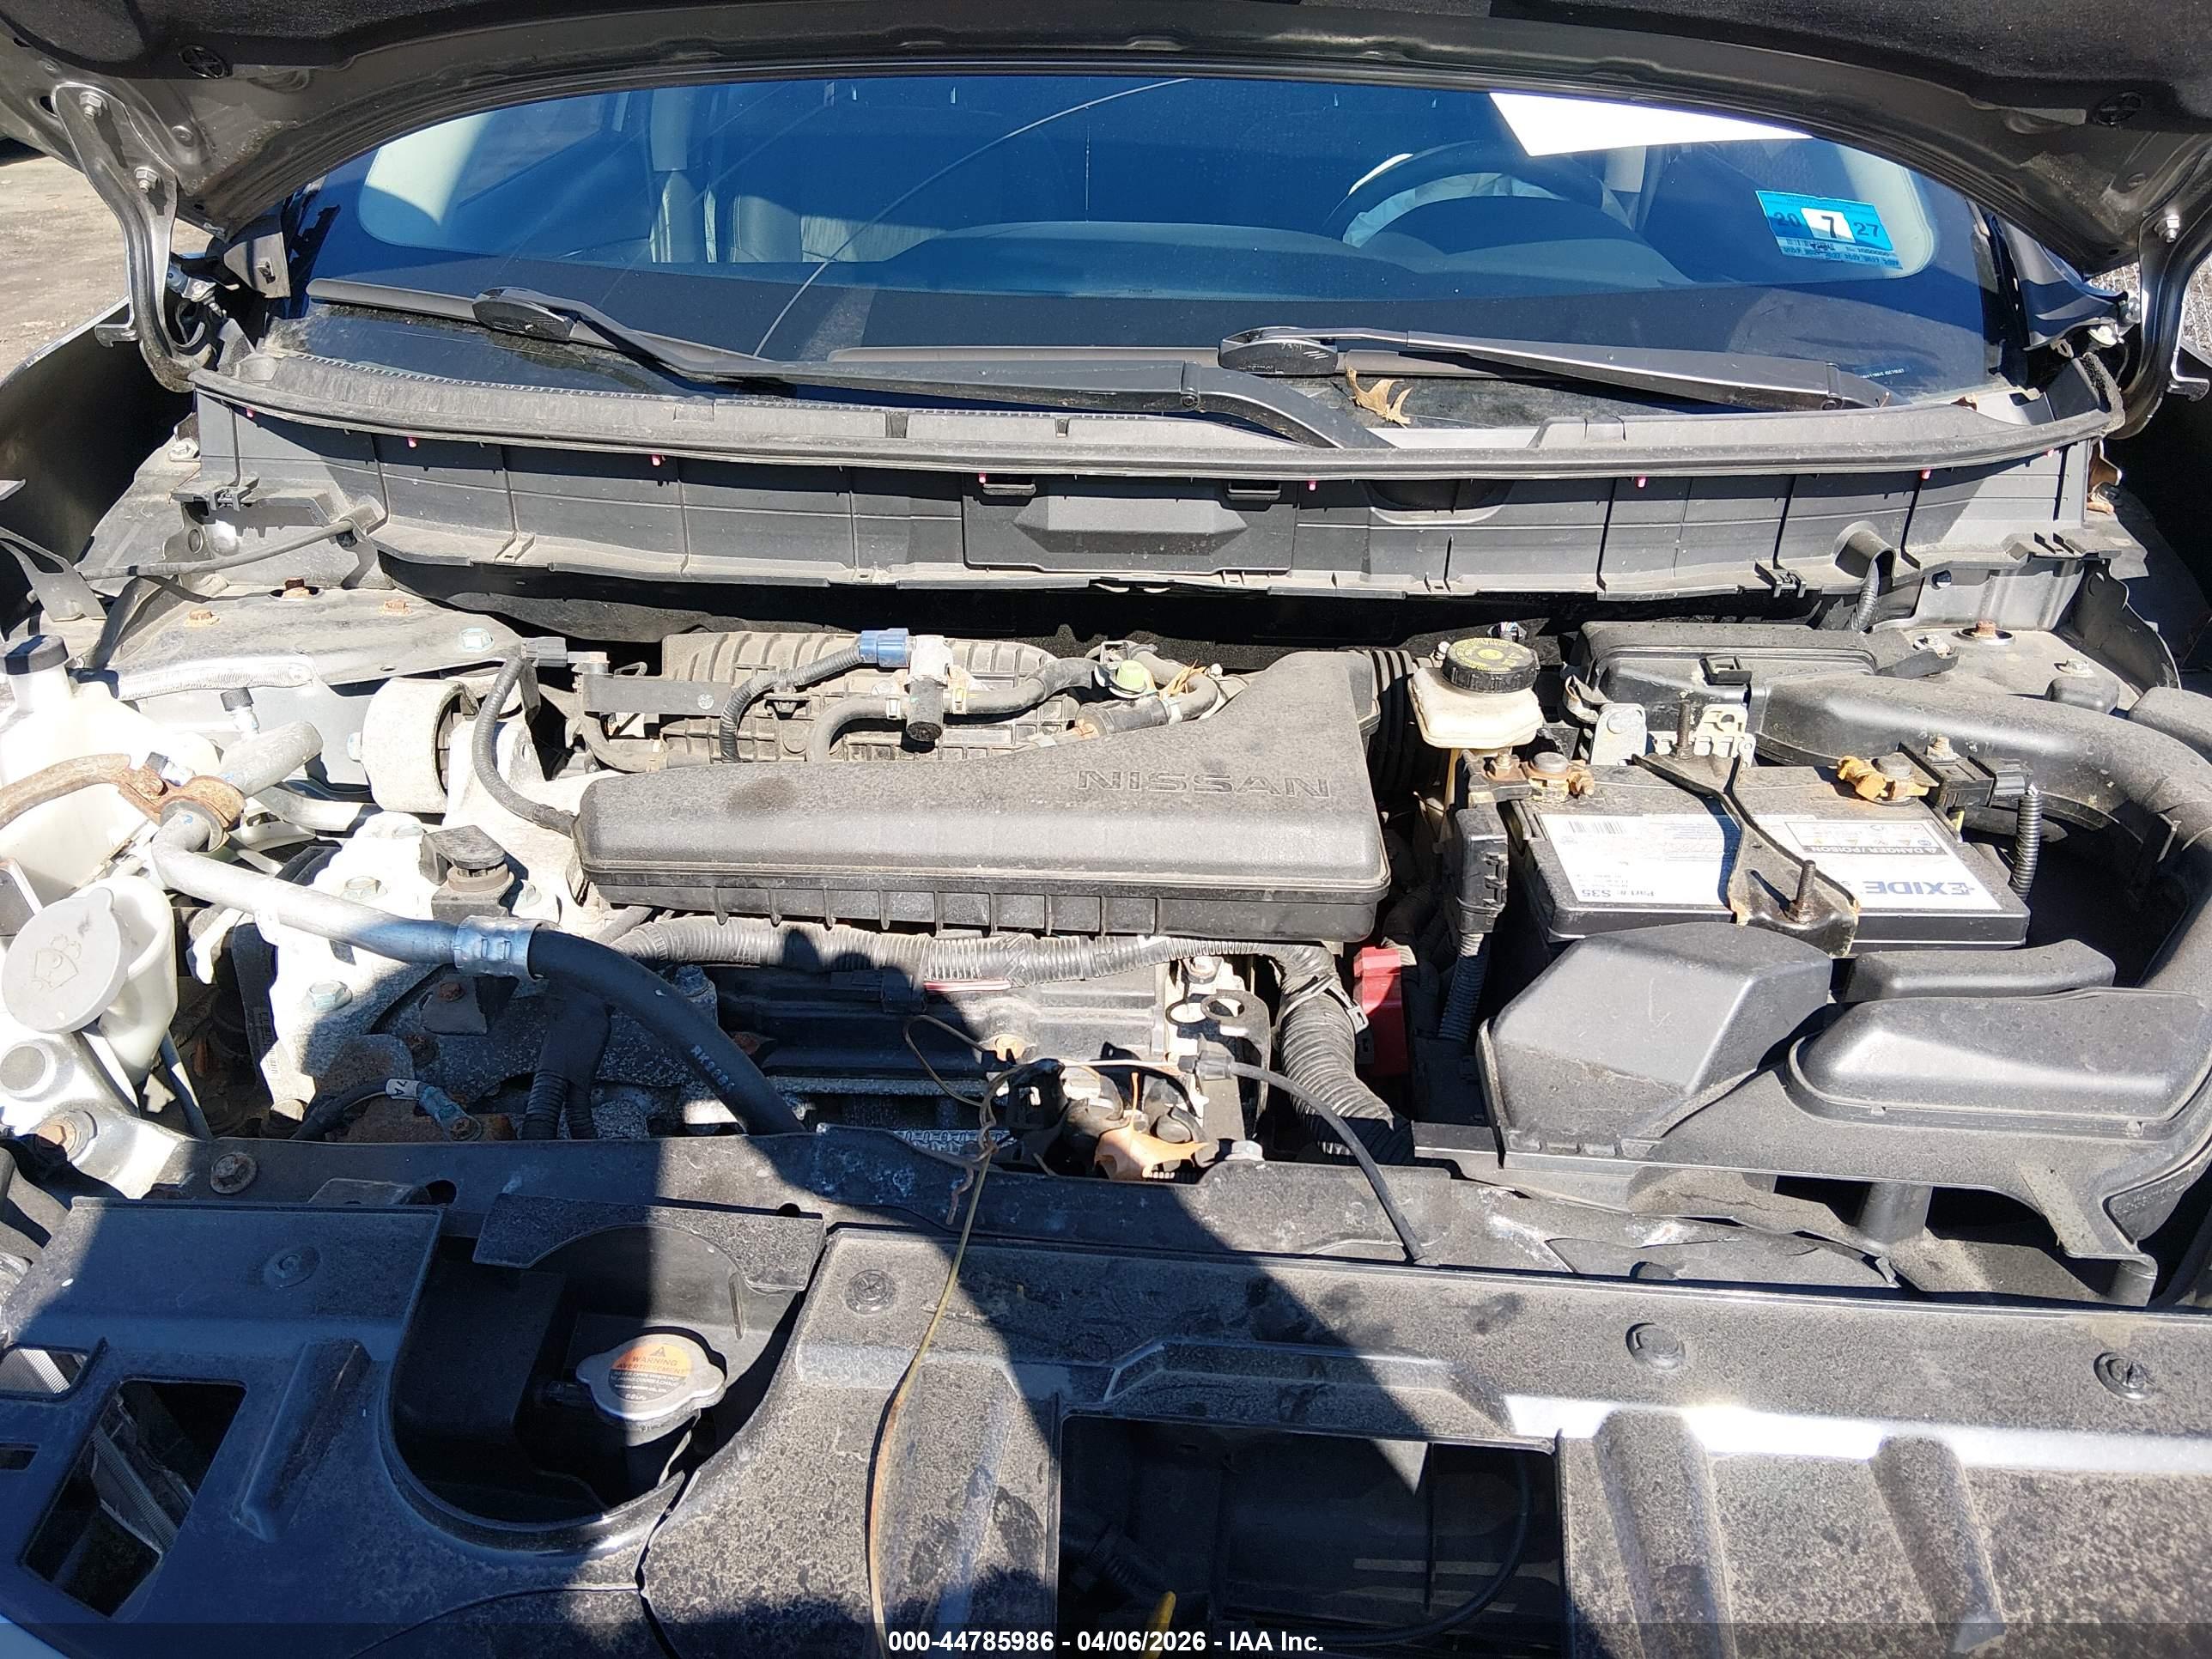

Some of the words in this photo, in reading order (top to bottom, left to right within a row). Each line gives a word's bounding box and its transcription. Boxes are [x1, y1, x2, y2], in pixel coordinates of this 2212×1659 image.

[1773, 211, 1802, 228] 20
[1820, 215, 1838, 239] 7
[1853, 221, 1880, 238] 27
[1077, 769, 1330, 799] NISSAN
[1581, 889, 1611, 898] S35
[1631, 889, 1656, 897] Part
[1862, 879, 1971, 896] EXIDE
[633, 1356, 678, 1366] WARNING
